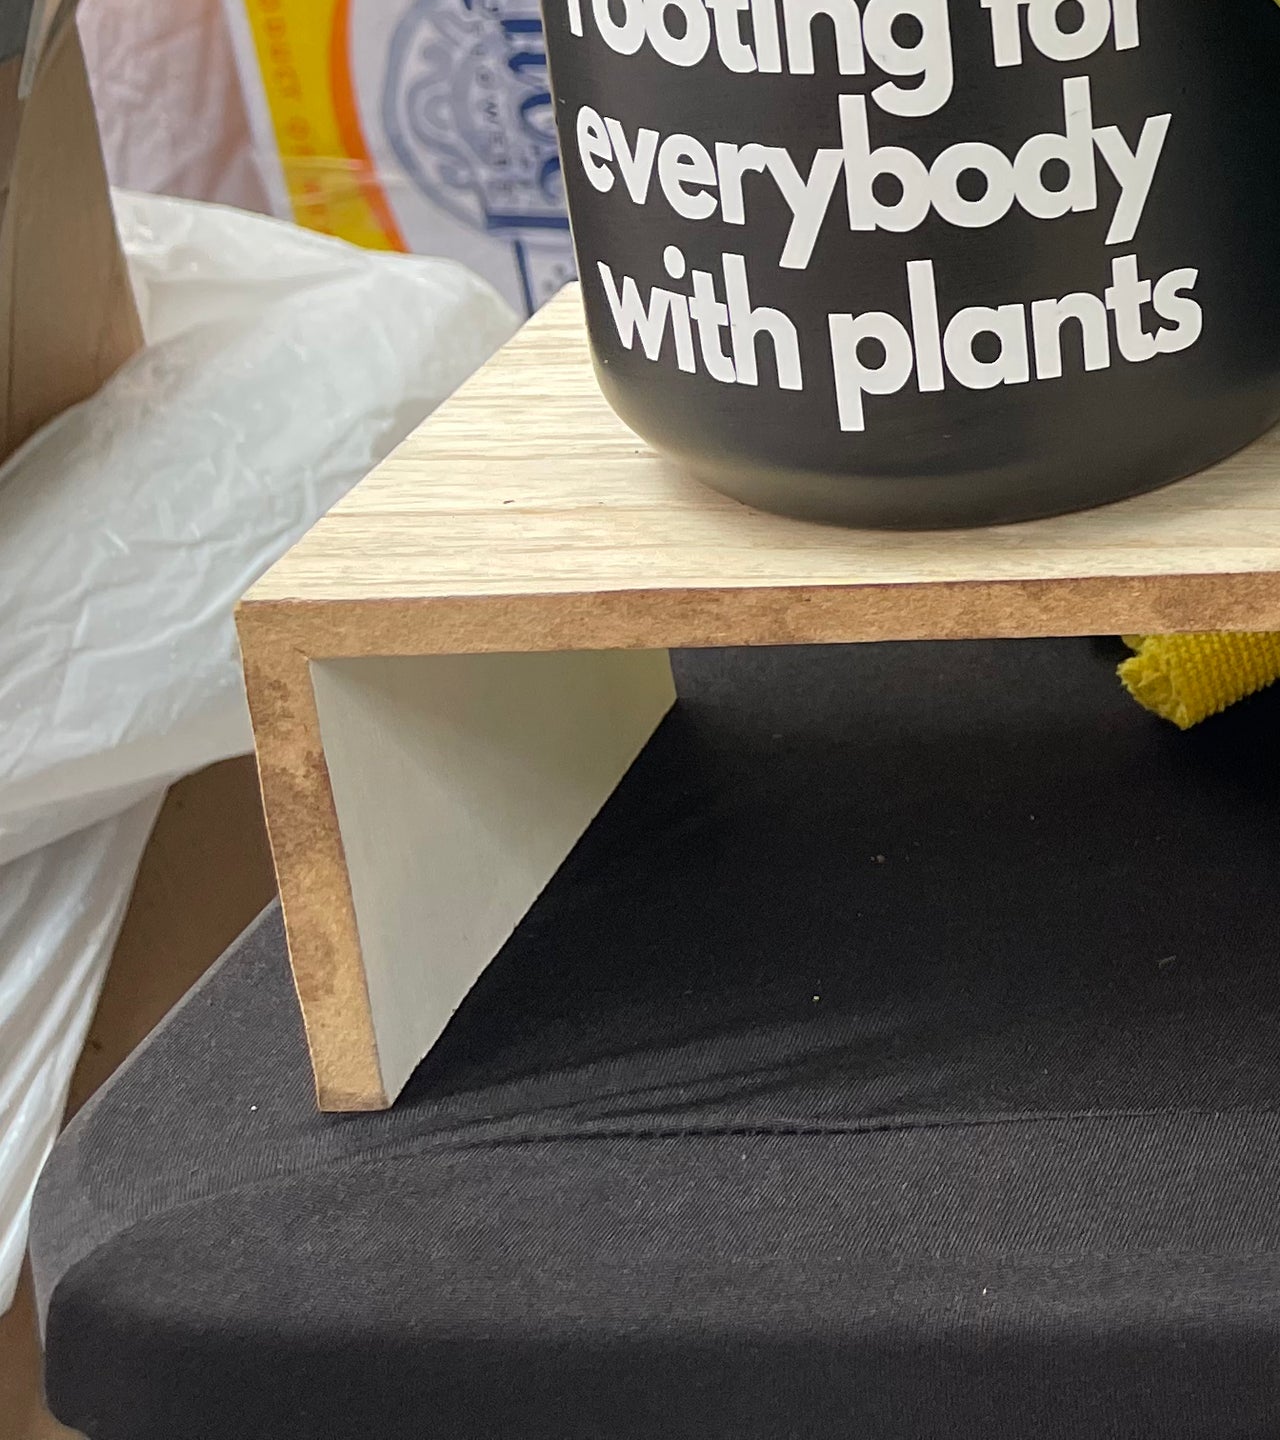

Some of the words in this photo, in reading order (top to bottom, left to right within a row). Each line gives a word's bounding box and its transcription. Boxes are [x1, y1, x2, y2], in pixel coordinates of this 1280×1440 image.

[576, 76, 1172, 270] everybody
[596, 245, 803, 391] with
[827, 254, 1203, 432] plants
